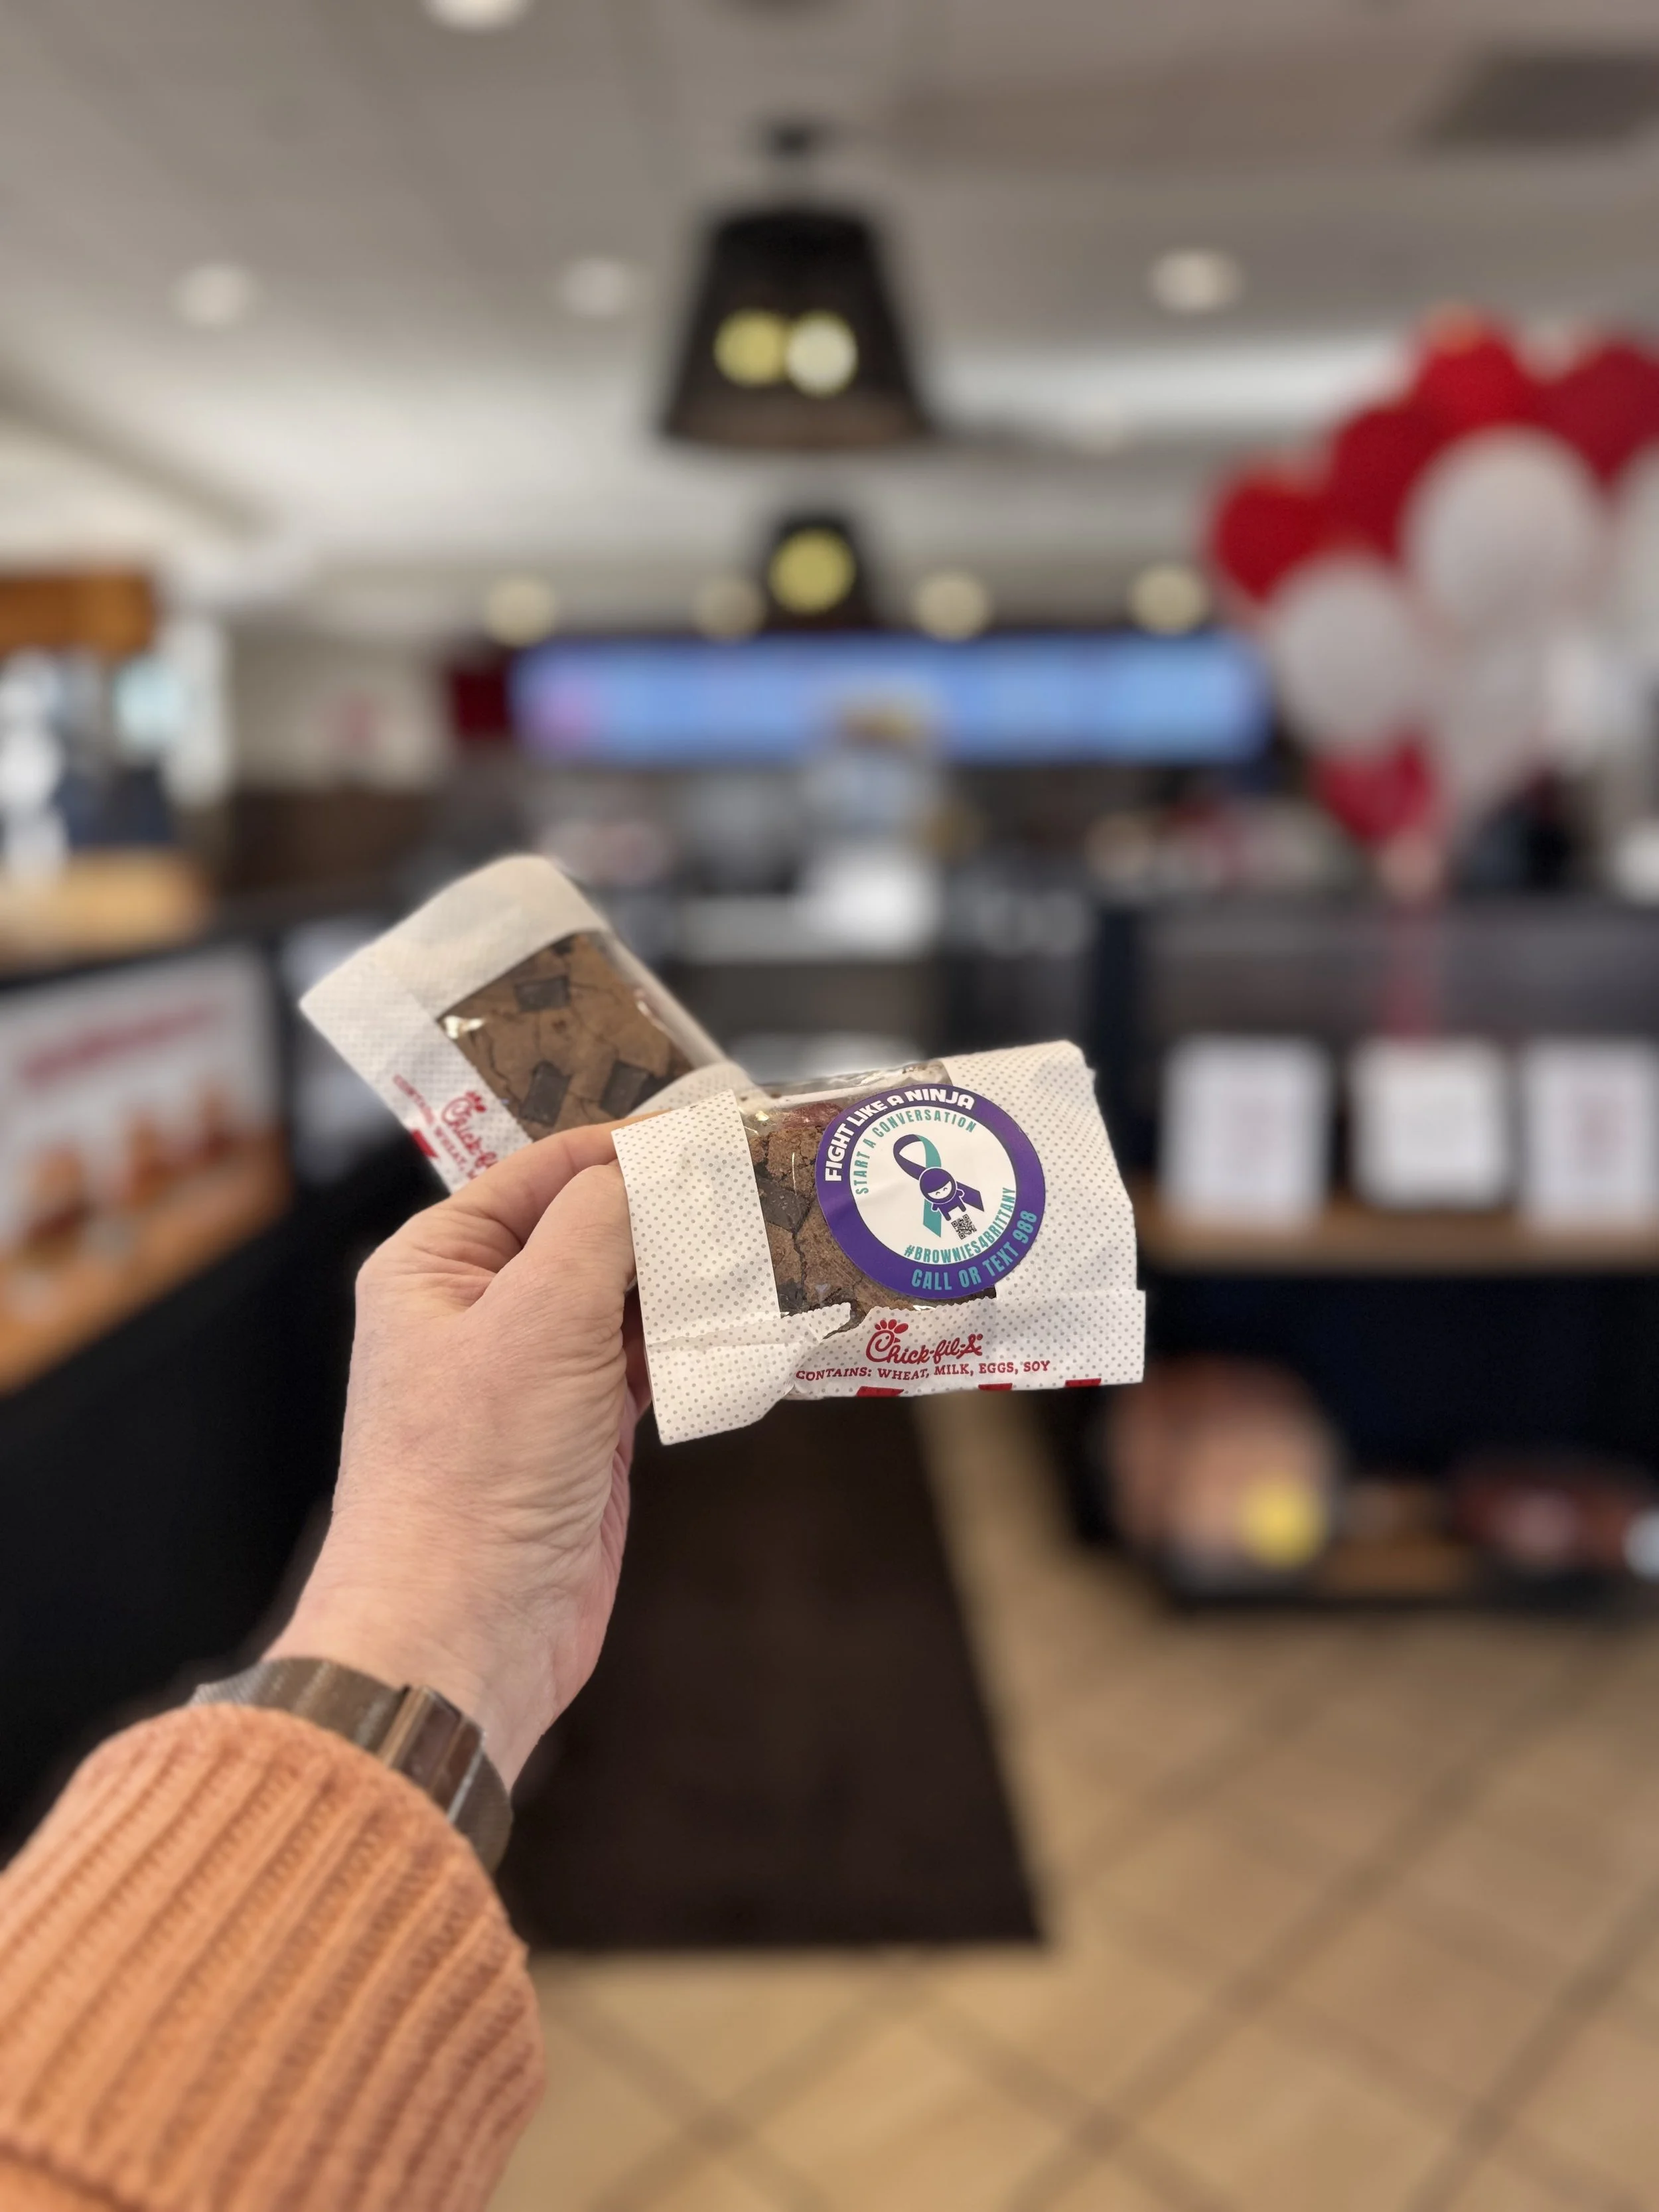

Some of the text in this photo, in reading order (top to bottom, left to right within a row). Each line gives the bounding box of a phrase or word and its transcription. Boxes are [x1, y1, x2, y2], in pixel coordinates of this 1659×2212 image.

[825, 1088, 975, 1181] FIGHT LIKE A NINJA
[853, 1109, 977, 1195] START A CONVERSATION
[904, 1187, 1015, 1264] #BROWNIES4BRITTANY
[910, 1210, 1037, 1290] CALL OR TEXT 988
[796, 1361, 1050, 1381] CONTAINS: WHEAT, MILK, EGGS, SOY
